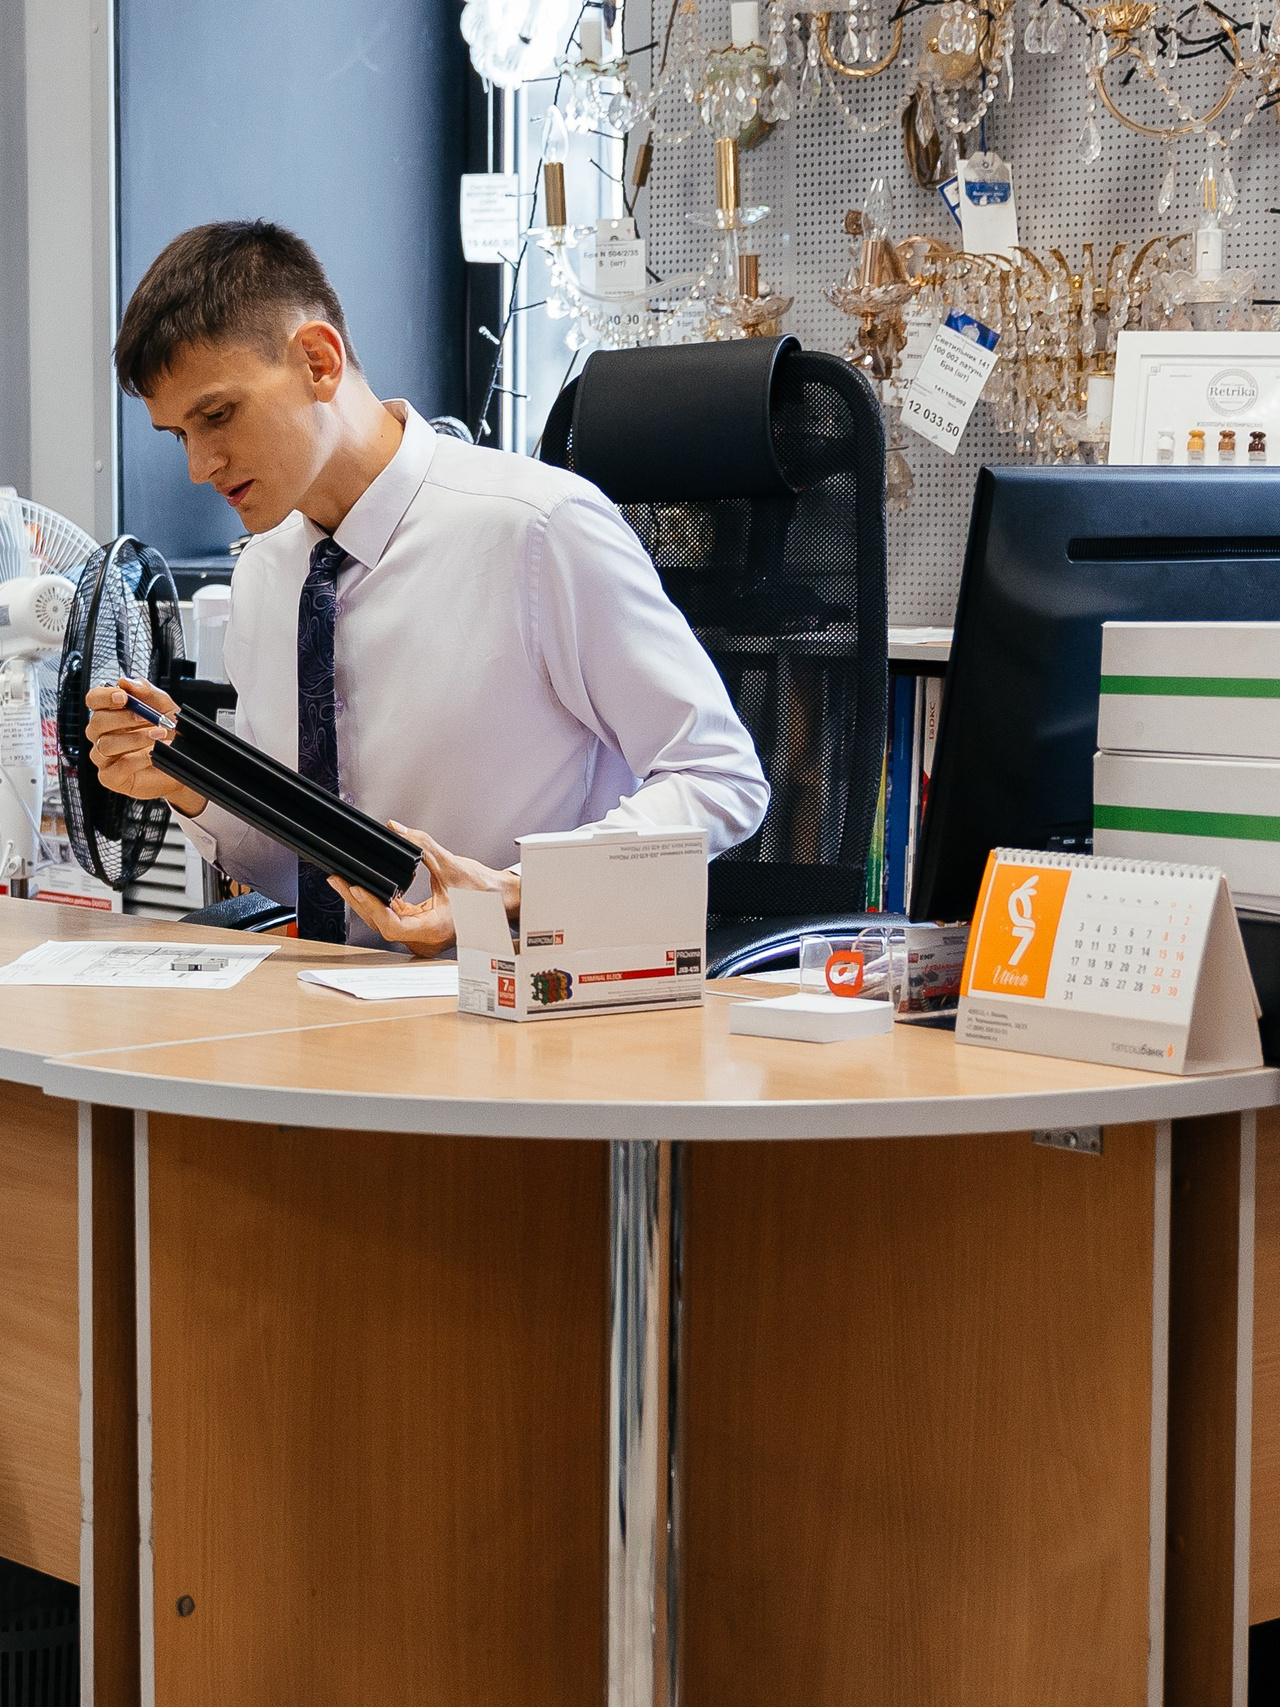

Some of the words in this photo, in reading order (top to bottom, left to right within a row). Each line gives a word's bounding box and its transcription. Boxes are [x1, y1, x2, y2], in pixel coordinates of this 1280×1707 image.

[933, 344, 945, 356] 100
[946, 351, 958, 363] 002
[959, 358, 983, 378] латунь
[935, 334, 976, 362] Светильник
[978, 357, 990, 369] 141
[940, 360, 954, 373] Бра
[955, 368, 970, 383] (шт)
[1209, 386, 1255, 397] Retrika
[908, 400, 921, 414] 12
[923, 408, 960, 437] 033,50
[1074, 939, 1083, 949] 10
[1091, 941, 1100, 951] 11
[1108, 943, 1117, 953] 12
[1124, 945, 1133, 955] 13
[1141, 947, 1150, 956] 14
[1159, 949, 1167, 959] 15
[1176, 951, 1185, 961] 16
[581, 974, 605, 983] TERMINAL
[606, 973, 622, 982] BLOCK
[1071, 956, 1080, 966] 17
[1087, 958, 1096, 968] 18
[1104, 960, 1113, 970] 19
[1119, 962, 1130, 972] 20
[1136, 964, 1147, 974] 21
[1153, 966, 1164, 977] 22
[1170, 968, 1181, 979] 23
[502, 979, 509, 991] 7
[1063, 990, 1073, 1000] 31
[1066, 973, 1077, 983] 24
[1083, 975, 1093, 986] 25
[1100, 977, 1109, 988] 26
[1116, 979, 1127, 990] 27
[1133, 981, 1144, 992] 28
[1150, 983, 1161, 994] 29
[1167, 986, 1178, 997] 30
